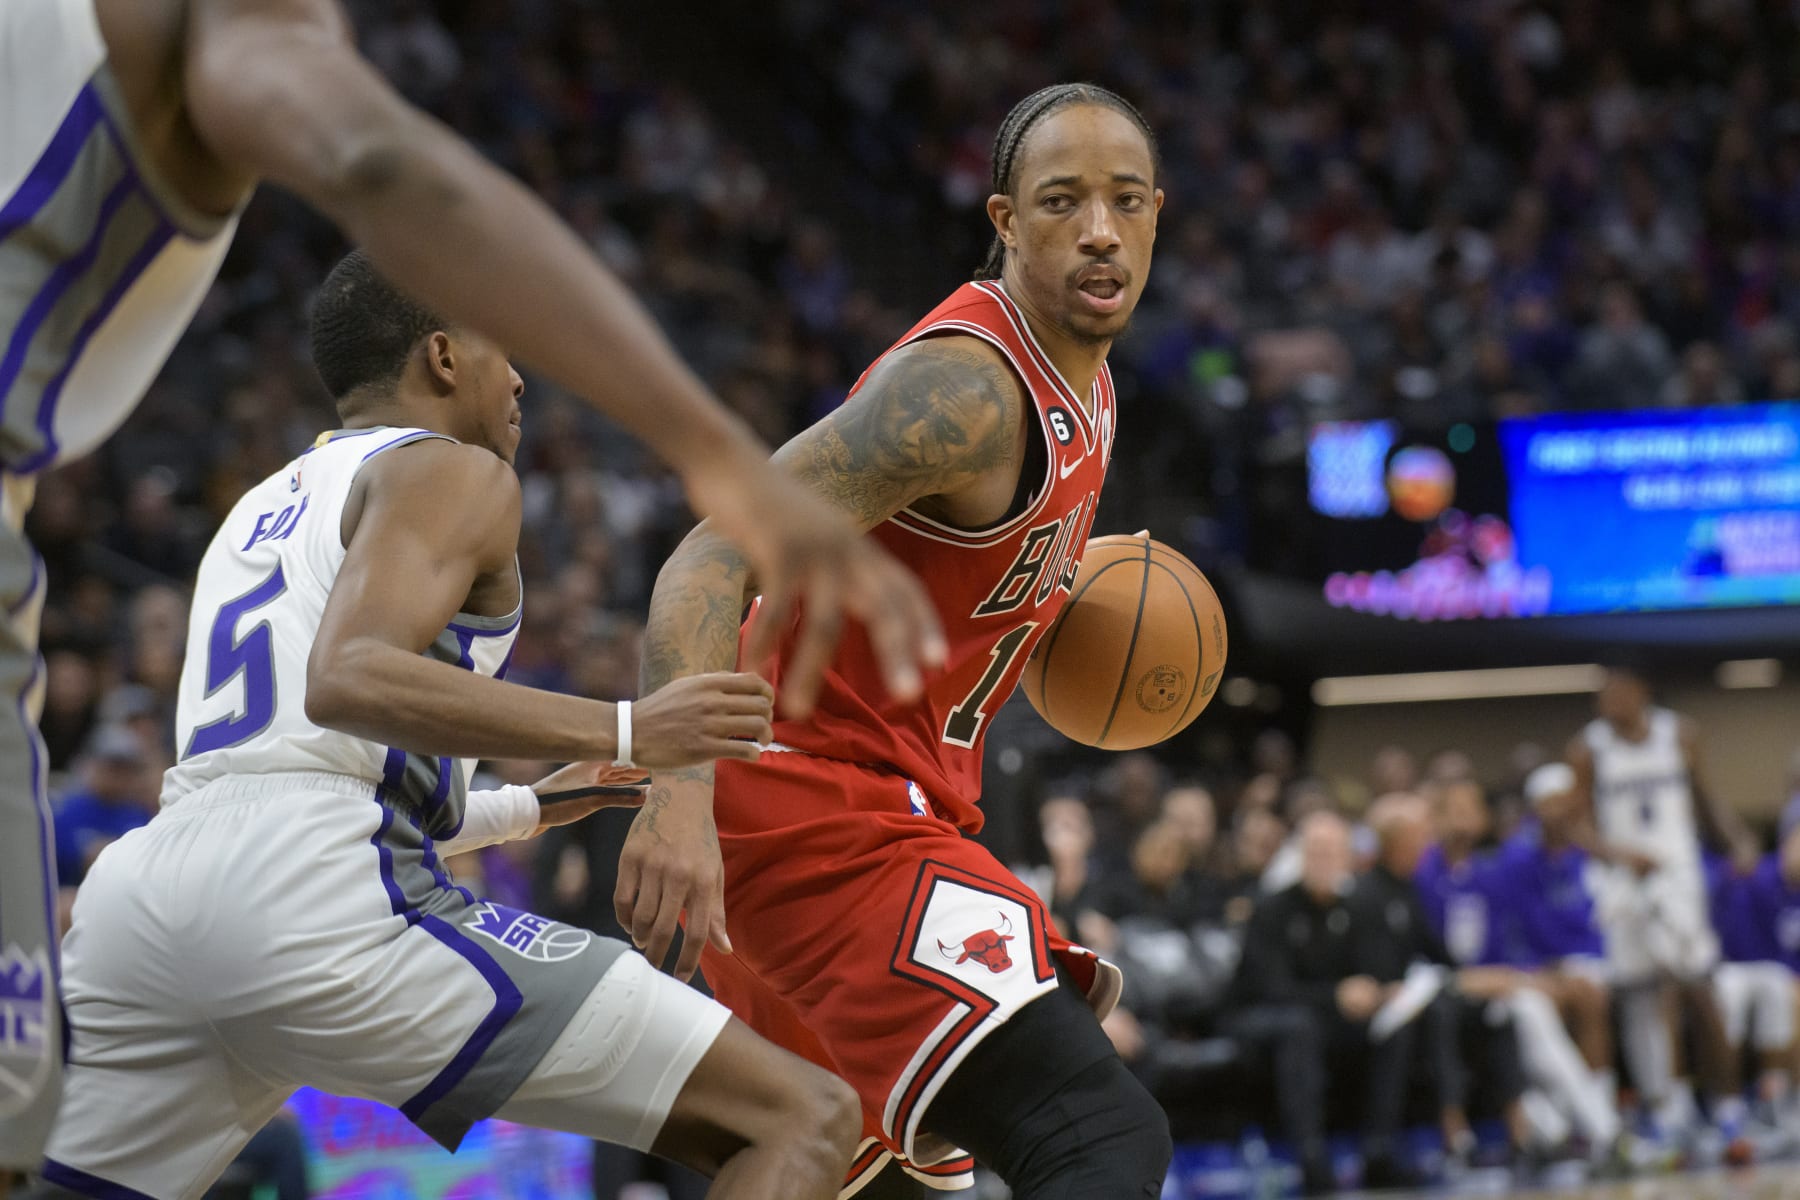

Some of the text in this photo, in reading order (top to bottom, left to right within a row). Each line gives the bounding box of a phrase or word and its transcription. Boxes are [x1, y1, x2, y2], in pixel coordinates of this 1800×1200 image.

[1049, 411, 1070, 442] 6
[241, 493, 310, 552] FOX
[969, 490, 1098, 618] BUL
[180, 554, 288, 761] 5
